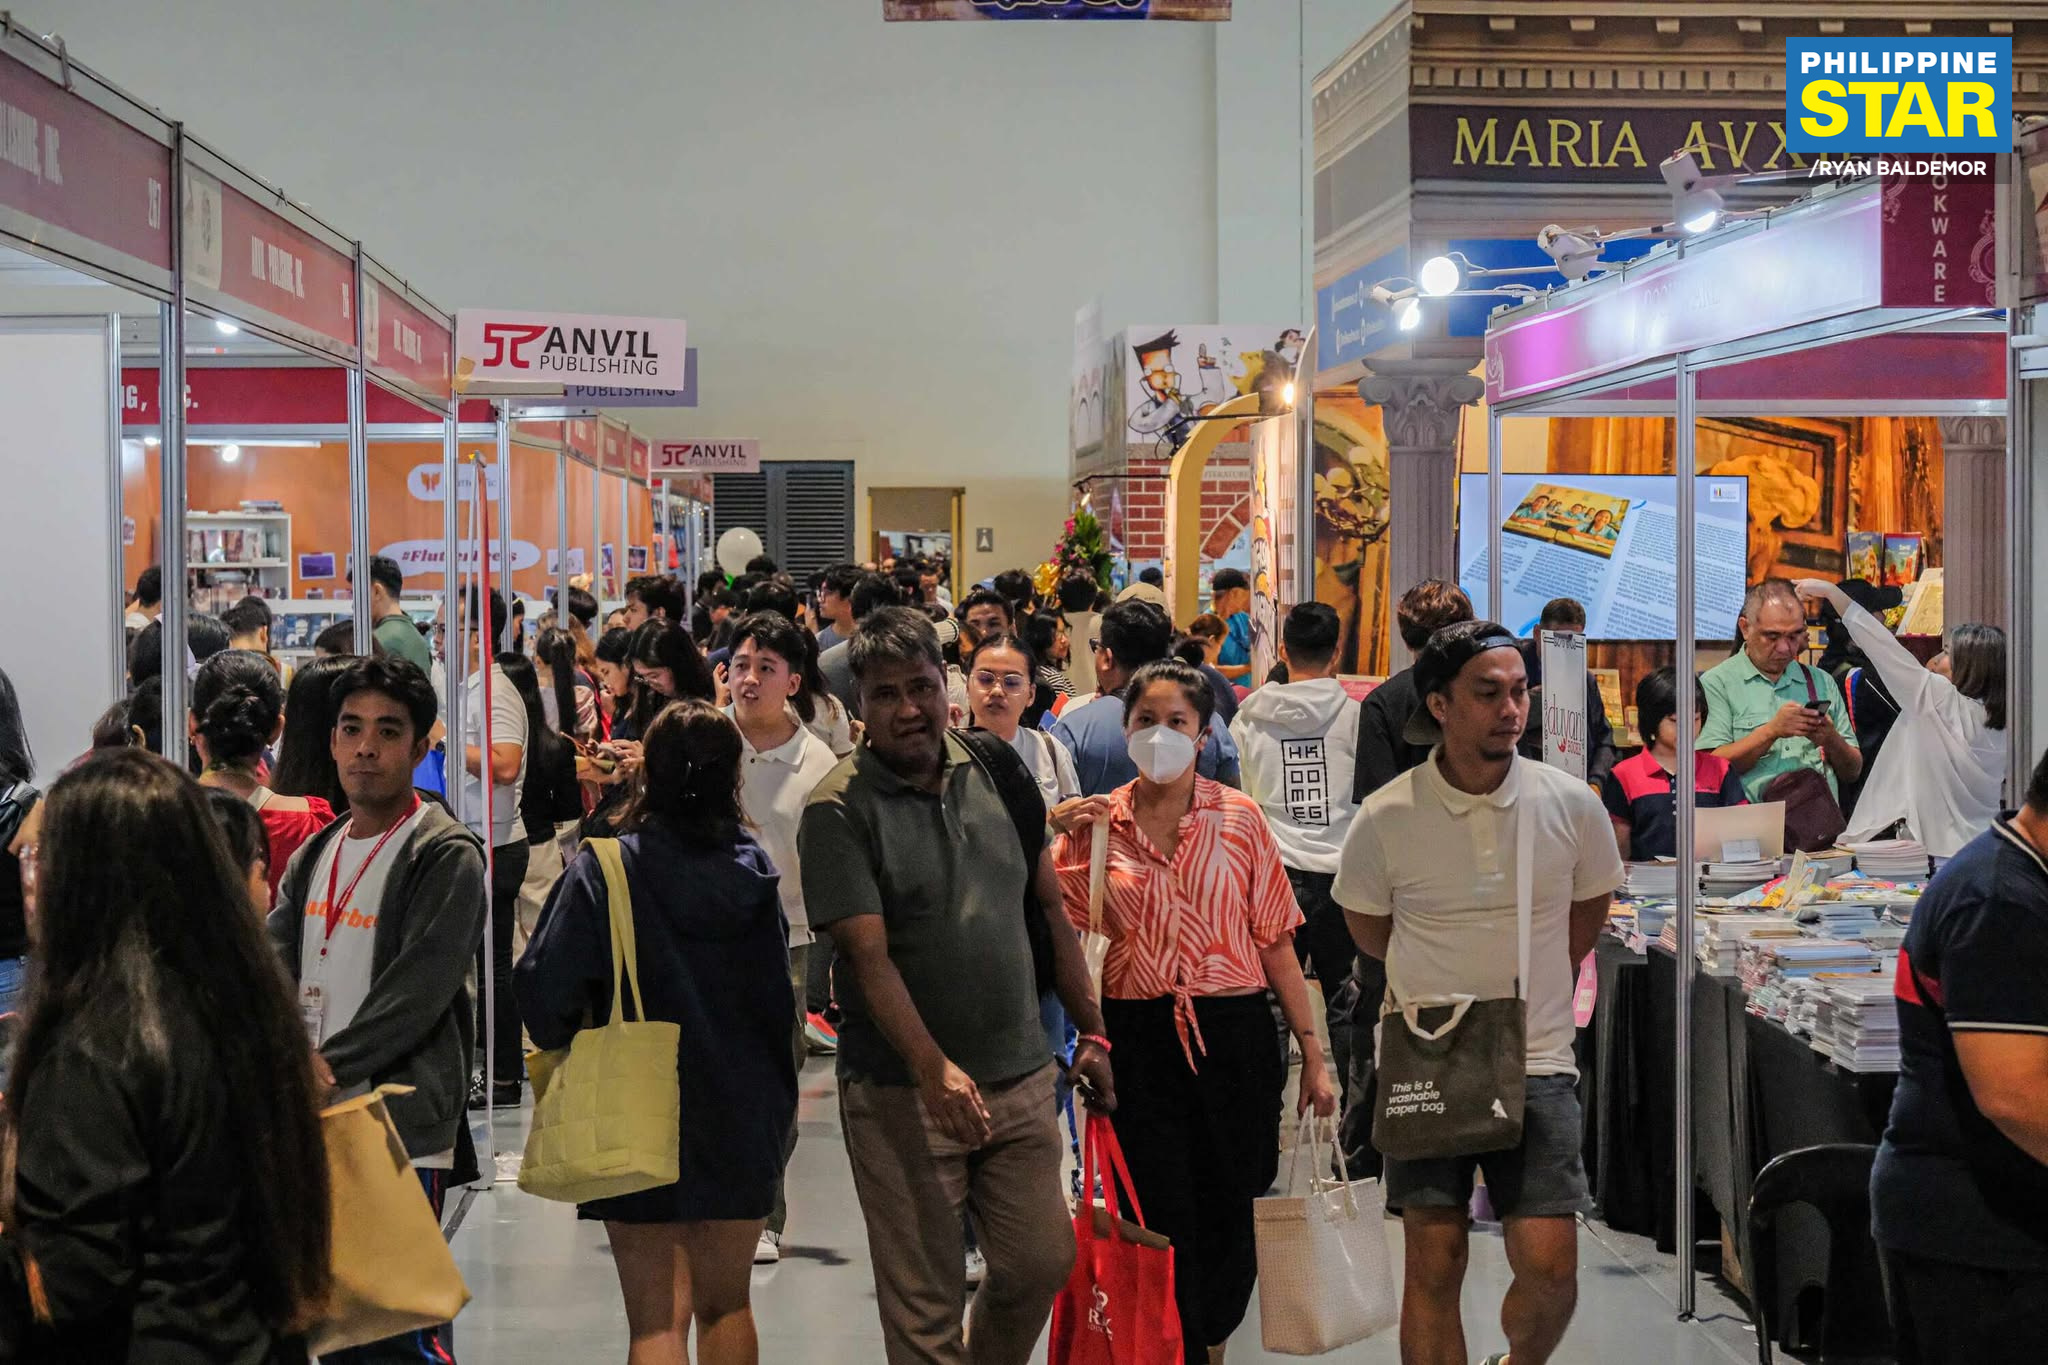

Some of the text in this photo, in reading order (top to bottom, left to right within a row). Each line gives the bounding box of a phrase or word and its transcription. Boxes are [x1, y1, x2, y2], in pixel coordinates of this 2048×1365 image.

[1452, 117, 1648, 169] MARIA
[543, 326, 659, 359] ANVIL
[539, 354, 659, 377] PUBLISHING
[691, 444, 747, 459] ANVIL
[1392, 1081, 1433, 1093] This is a
[1389, 1090, 1440, 1104] washable
[1386, 1102, 1446, 1118] paper bag.
